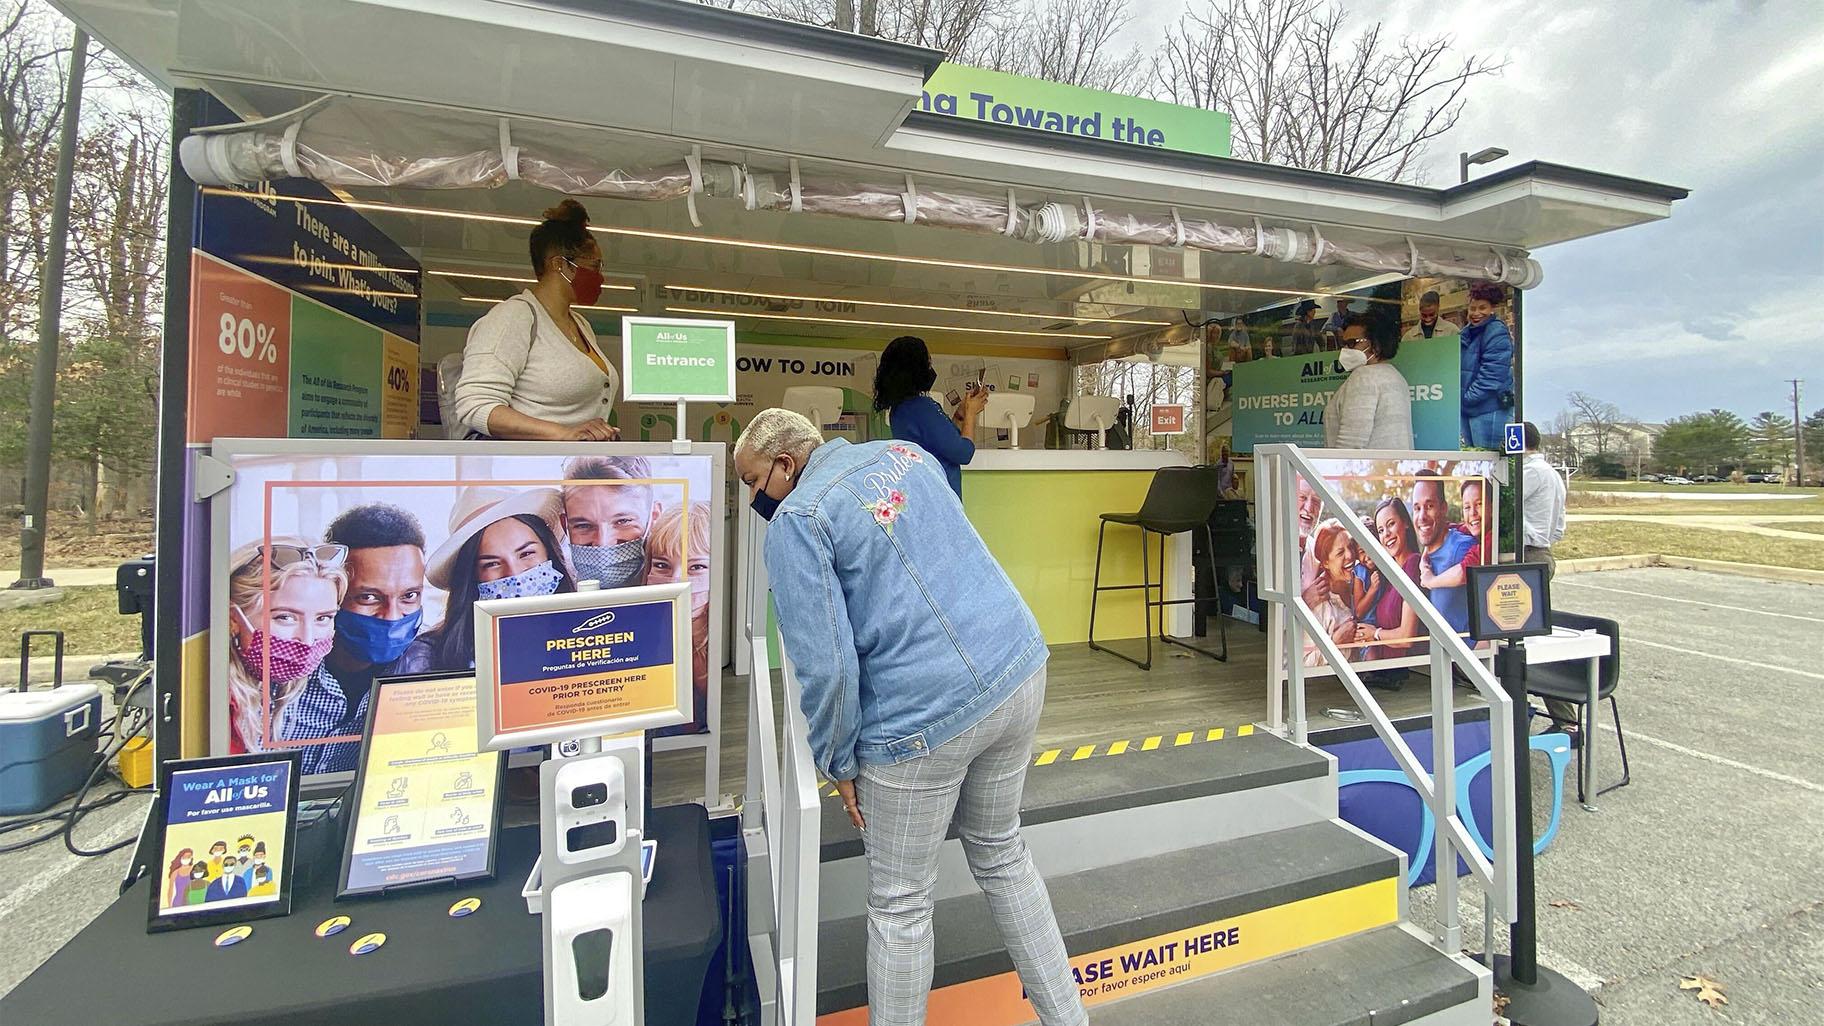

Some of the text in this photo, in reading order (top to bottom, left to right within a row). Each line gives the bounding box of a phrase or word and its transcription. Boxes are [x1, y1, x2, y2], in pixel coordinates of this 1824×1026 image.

[970, 92, 1100, 138] Toward
[1112, 117, 1165, 147] the
[295, 201, 330, 243] There
[332, 231, 349, 256] are
[351, 244, 357, 261] a
[359, 249, 387, 280] million
[293, 241, 398, 314] to join. What's yours?
[219, 313, 277, 363] 80%
[656, 332, 669, 340] All
[675, 333, 688, 341] Us
[646, 353, 716, 367] Entrance
[736, 357, 855, 377] OW TO JOIN
[1301, 361, 1323, 377] All
[388, 366, 409, 393] 40%
[1239, 384, 1443, 410] DIVERSE DAT ERS
[1157, 416, 1177, 425] Exit
[1274, 411, 1294, 426] TO
[546, 632, 634, 651] PRESCREEN
[542, 664, 575, 672] Preguntas
[586, 657, 624, 667] Verificación
[625, 655, 639, 664] aquí
[571, 648, 611, 661] HERE
[528, 674, 647, 695] COVID-19 PRESCREEN HERE
[553, 691, 580, 700] PRIOR
[596, 685, 624, 694] ENTRY
[555, 697, 622, 710] Responda cuestionario
[556, 707, 586, 716] COVID-19
[183, 774, 278, 791] Wear A Mask for
[205, 785, 268, 804] All of Us
[186, 809, 199, 817] Por
[201, 807, 220, 815] favor
[235, 802, 272, 811] mascarilla.
[1121, 943, 1177, 973] WAIT
[1185, 927, 1239, 957] HERE
[1080, 961, 1191, 999] Por favor espere aquí
